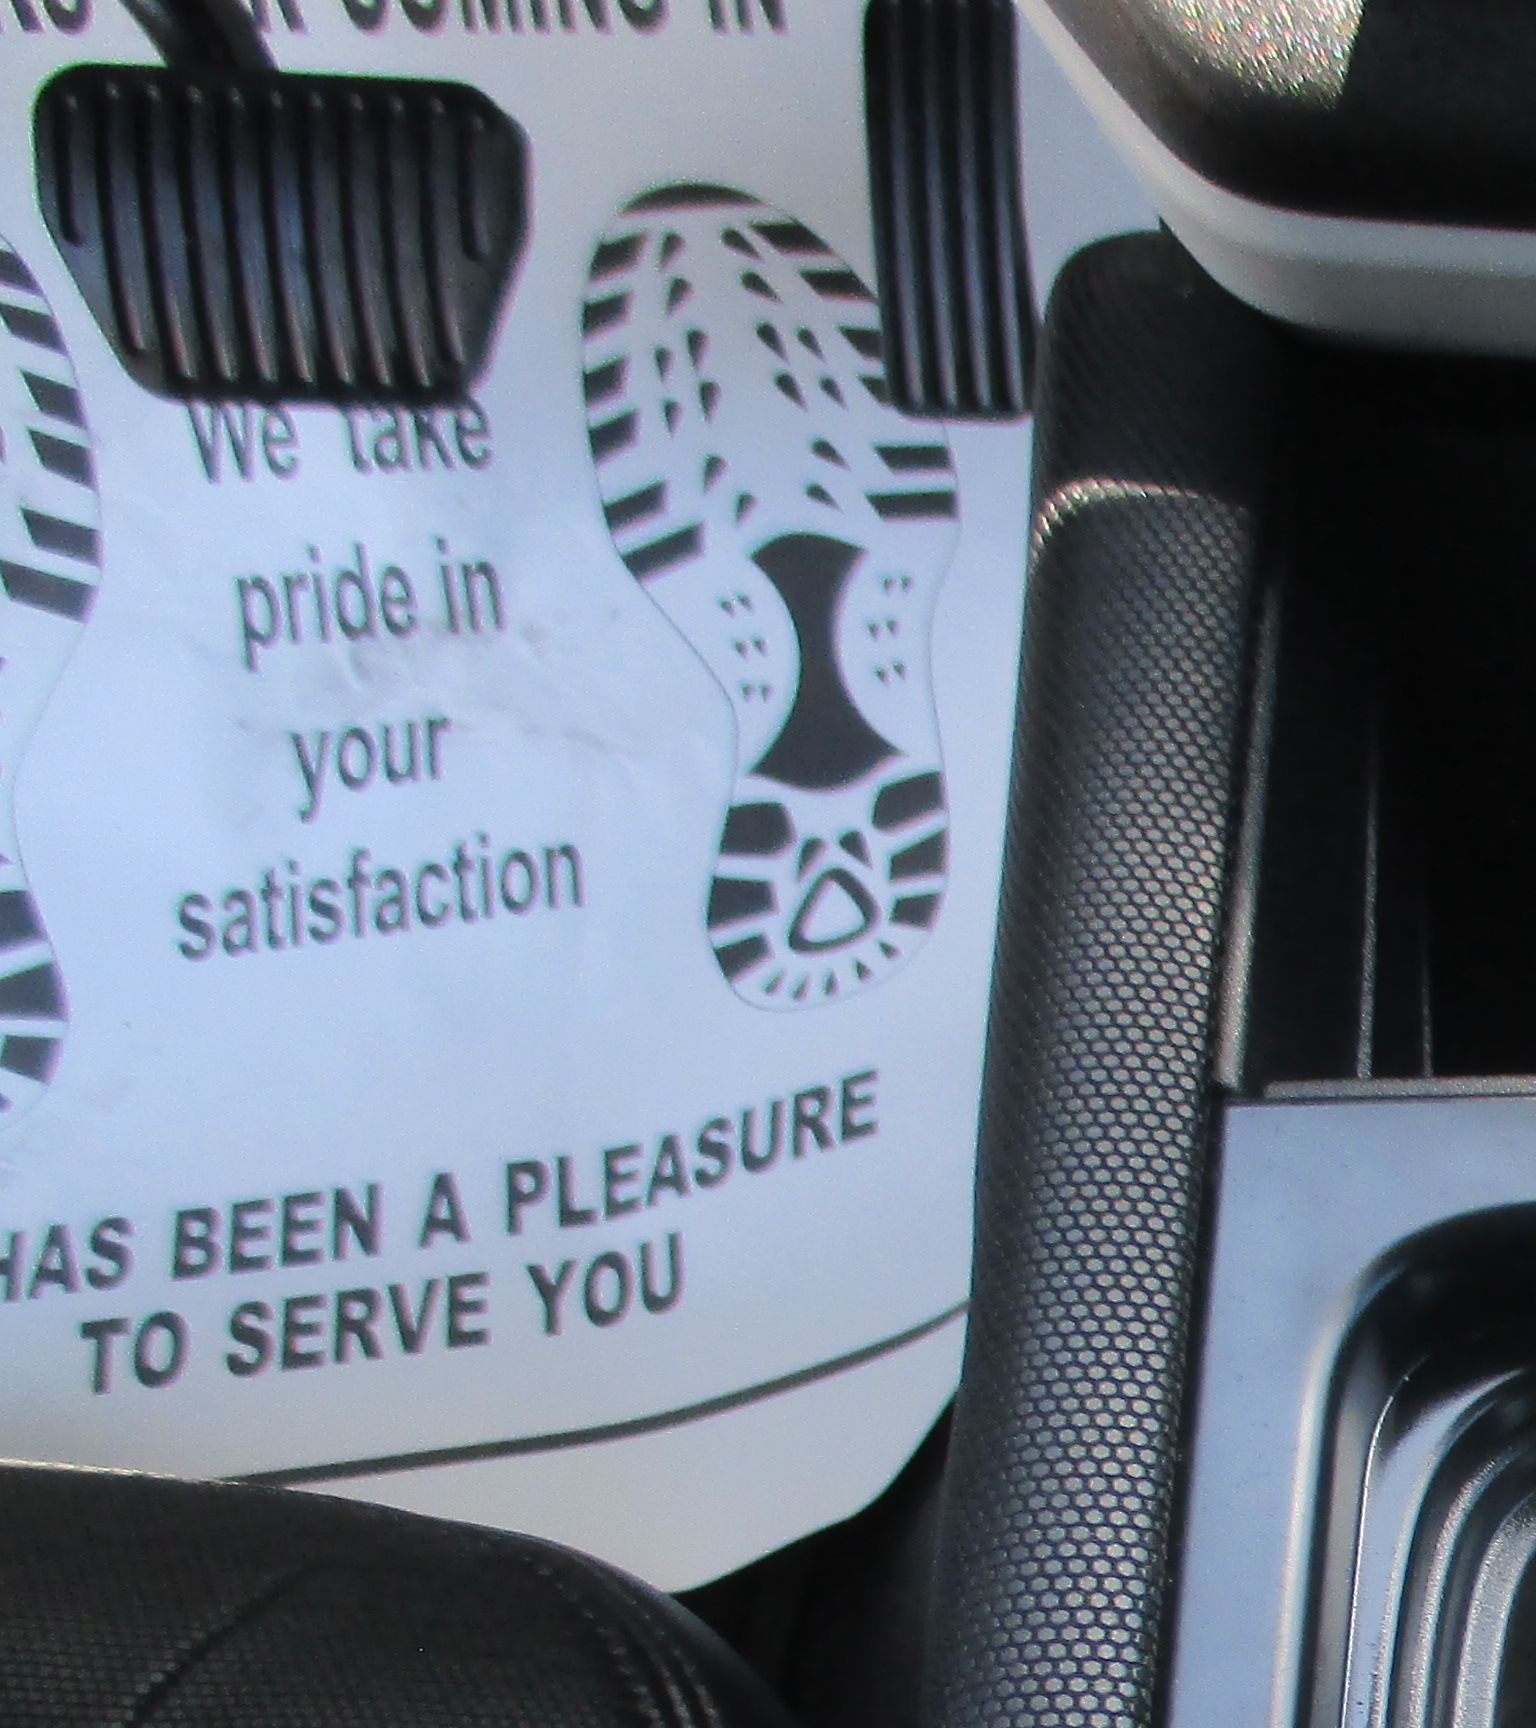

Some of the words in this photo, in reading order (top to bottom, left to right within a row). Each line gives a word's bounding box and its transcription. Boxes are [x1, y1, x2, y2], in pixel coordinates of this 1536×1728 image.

[187, 400, 298, 483] We
[234, 541, 418, 673] pride
[434, 533, 507, 634] in
[289, 714, 452, 819] your
[174, 833, 585, 960] satisfaction
[171, 1181, 384, 1281] BEEN
[418, 1171, 470, 1249] A
[504, 1068, 881, 1237] PLEASURE
[80, 1311, 191, 1396] TO
[225, 1271, 490, 1379] SERVE
[527, 1230, 686, 1337] YOU
